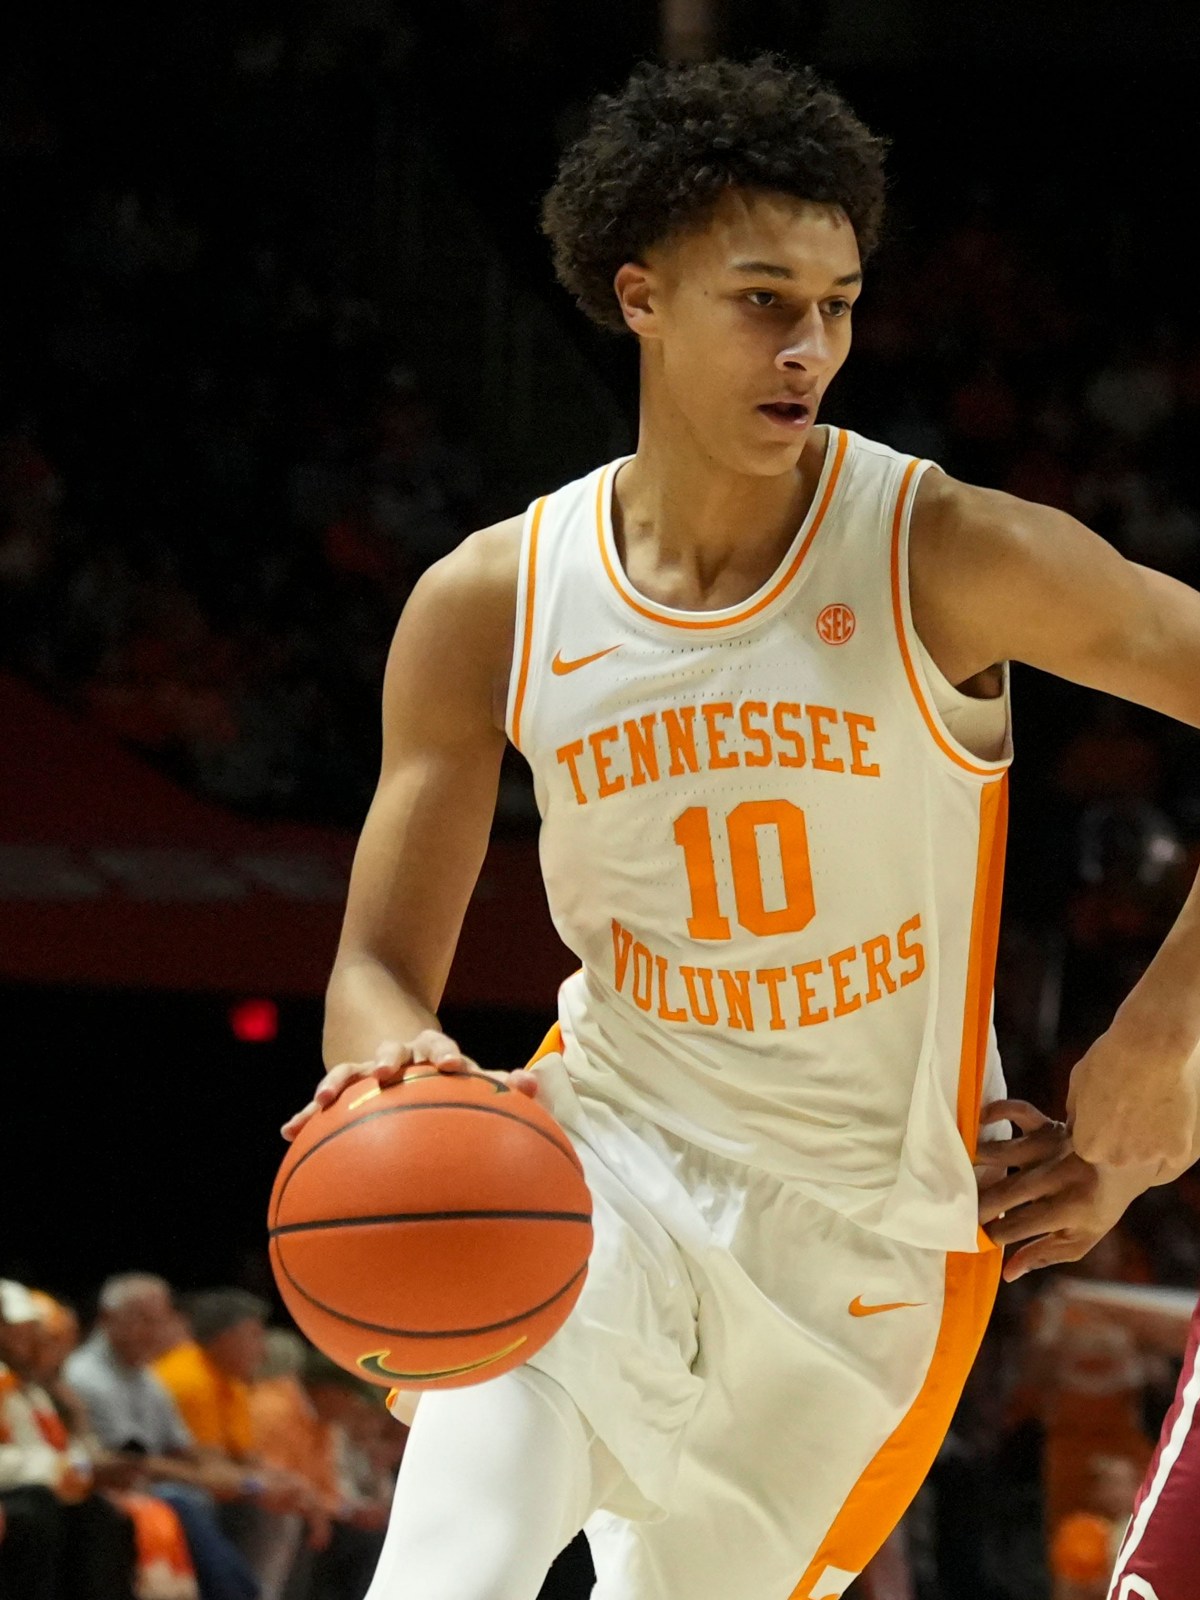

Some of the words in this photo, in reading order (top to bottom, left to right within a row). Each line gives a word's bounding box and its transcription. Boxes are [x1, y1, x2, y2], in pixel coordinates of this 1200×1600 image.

[819, 606, 854, 642] SEC
[556, 701, 881, 805] TENNESSEE
[673, 799, 816, 941] 10
[611, 914, 926, 1032] VOLUNTEERS
